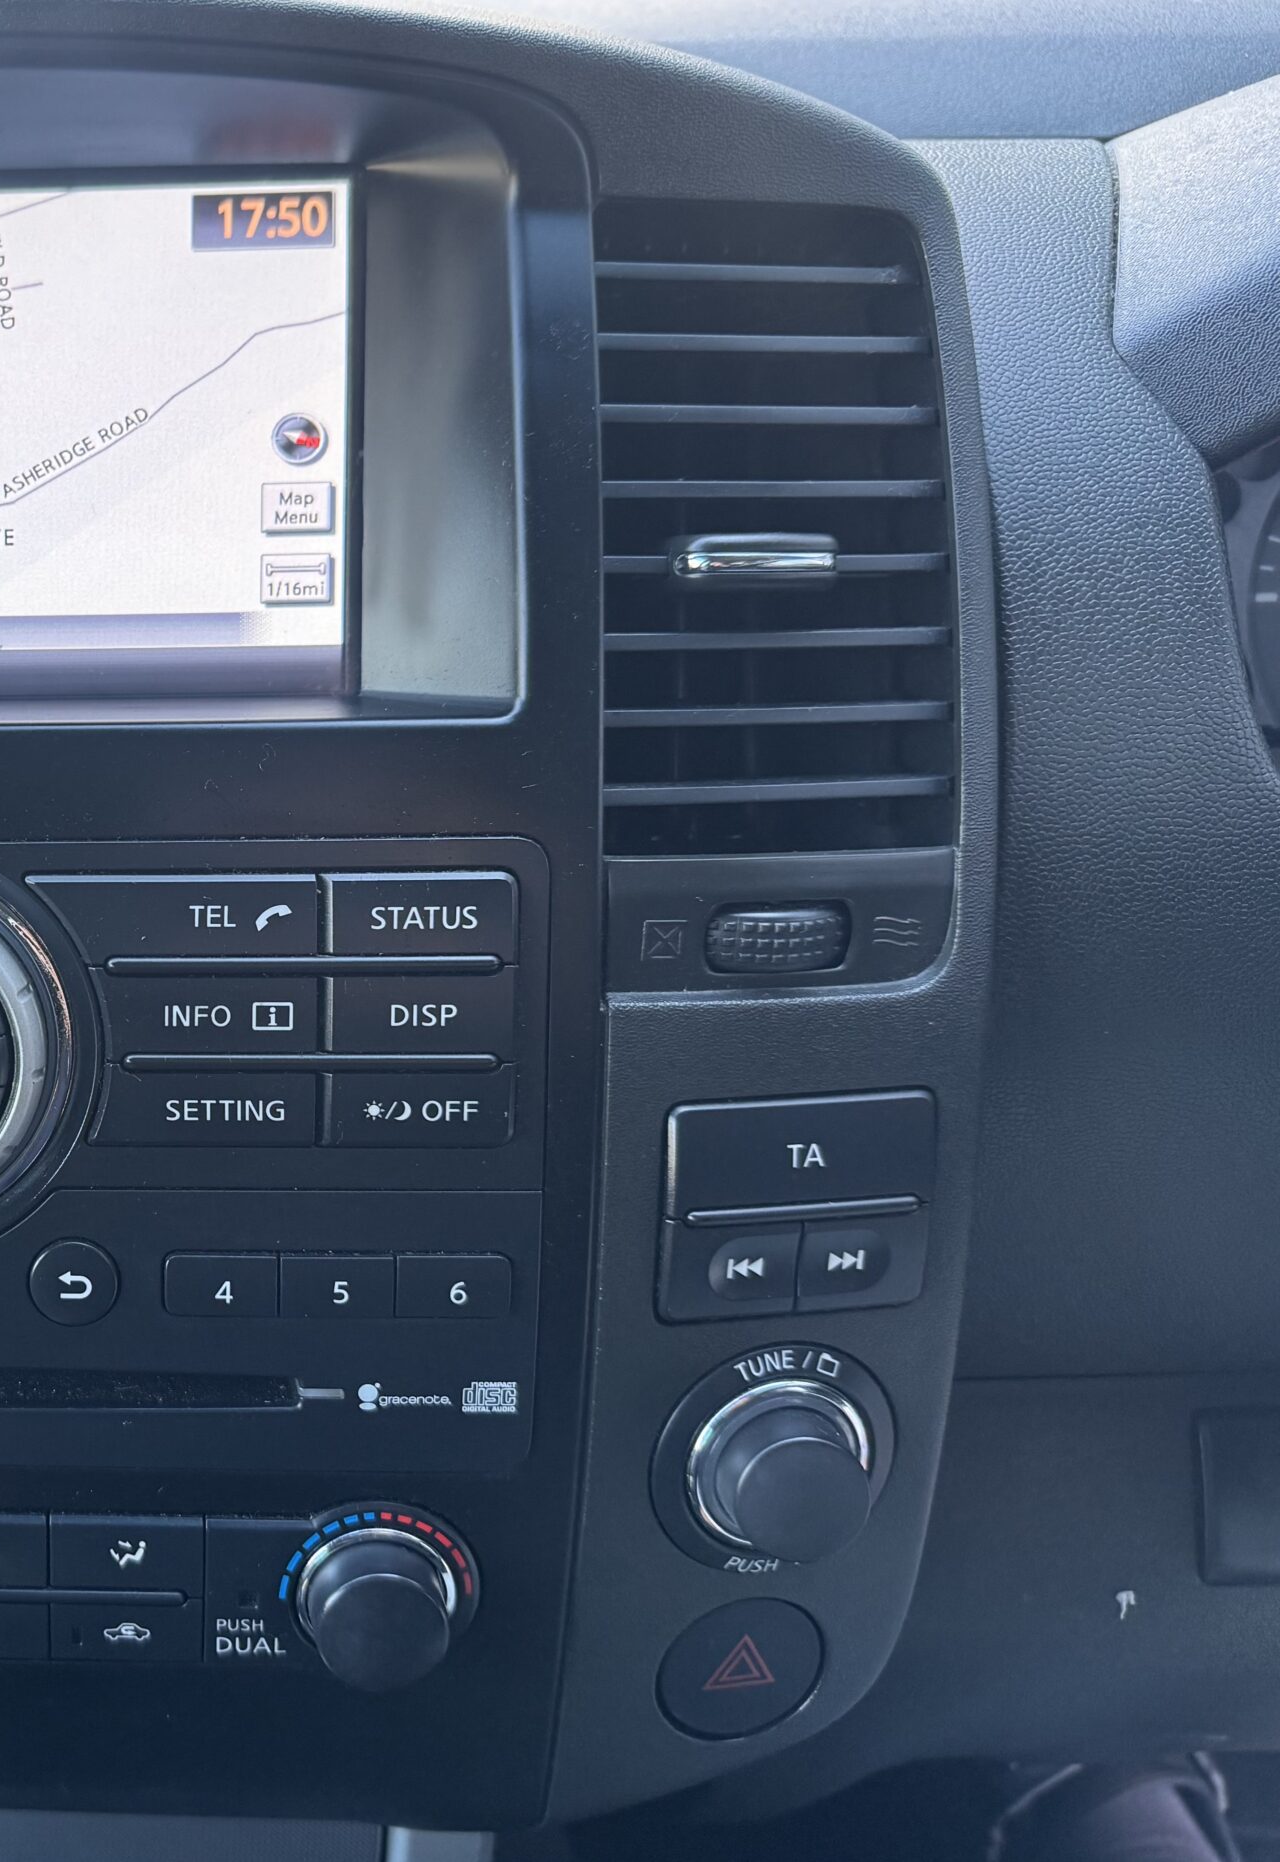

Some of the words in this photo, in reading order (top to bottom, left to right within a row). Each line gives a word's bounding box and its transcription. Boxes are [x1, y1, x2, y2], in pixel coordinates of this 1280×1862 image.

[217, 196, 328, 240] 17:50
[2, 436, 96, 499] ASHERIDGE
[97, 406, 149, 444] ROAD
[278, 491, 314, 507] Map
[274, 509, 319, 525] Menu
[266, 581, 325, 597] 1/16mi
[189, 904, 236, 928] TEL
[371, 906, 478, 931] STATUS
[164, 1005, 232, 1028] INFO
[390, 1004, 458, 1028] DISP
[165, 1100, 286, 1122] SETTING
[422, 1100, 479, 1122] OFF
[787, 1143, 826, 1169] TA
[214, 1280, 233, 1304] 4
[332, 1281, 350, 1304] 5
[449, 1281, 468, 1305] 6
[734, 1350, 796, 1382] TUNE
[723, 1556, 780, 1573] PUSH
[216, 1618, 264, 1633] PUSH
[216, 1635, 287, 1655] DUAL
